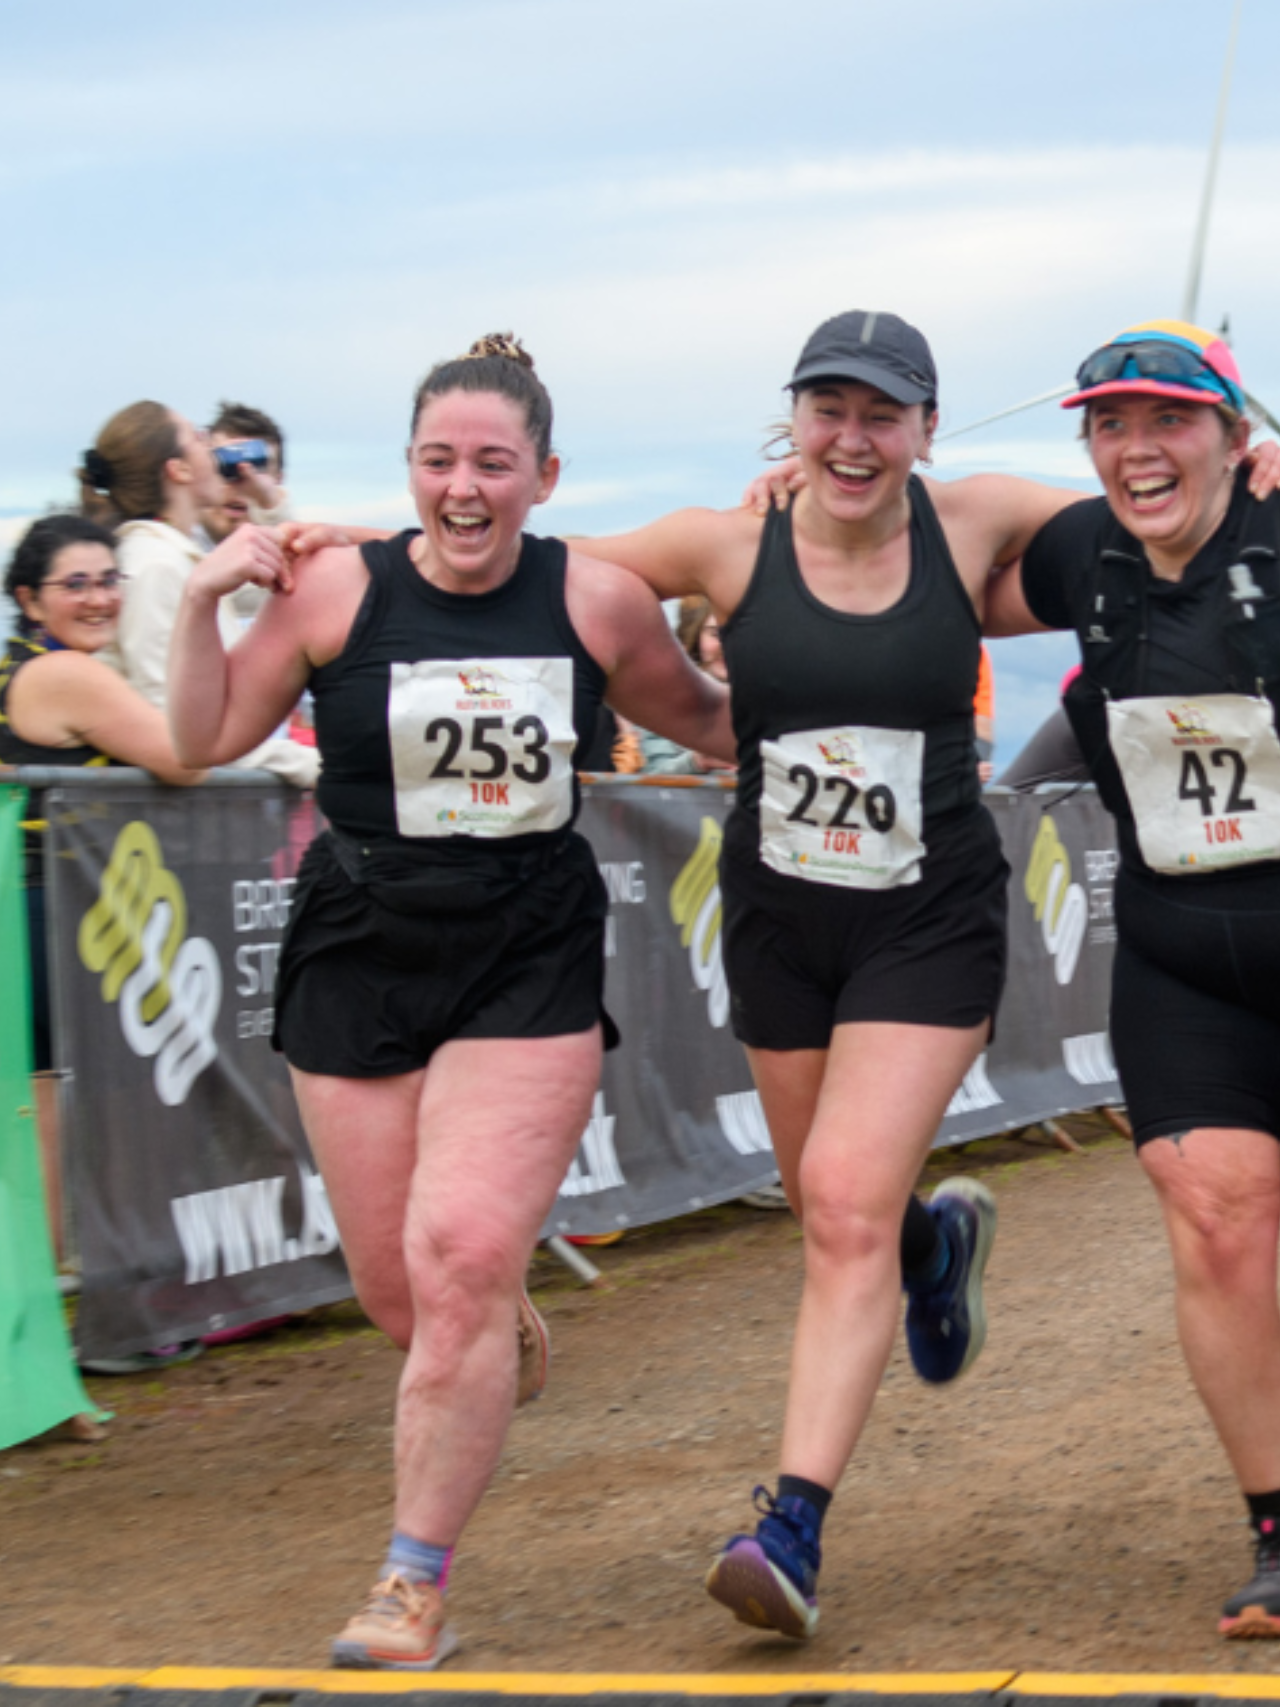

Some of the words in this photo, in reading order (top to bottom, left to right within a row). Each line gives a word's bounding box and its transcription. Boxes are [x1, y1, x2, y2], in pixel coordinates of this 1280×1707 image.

[424, 715, 552, 785] 253
[470, 782, 510, 806] 10K
[785, 764, 897, 835] 220
[1178, 747, 1256, 816] 42
[822, 829, 862, 856] 10K
[1203, 818, 1243, 845] 10K
